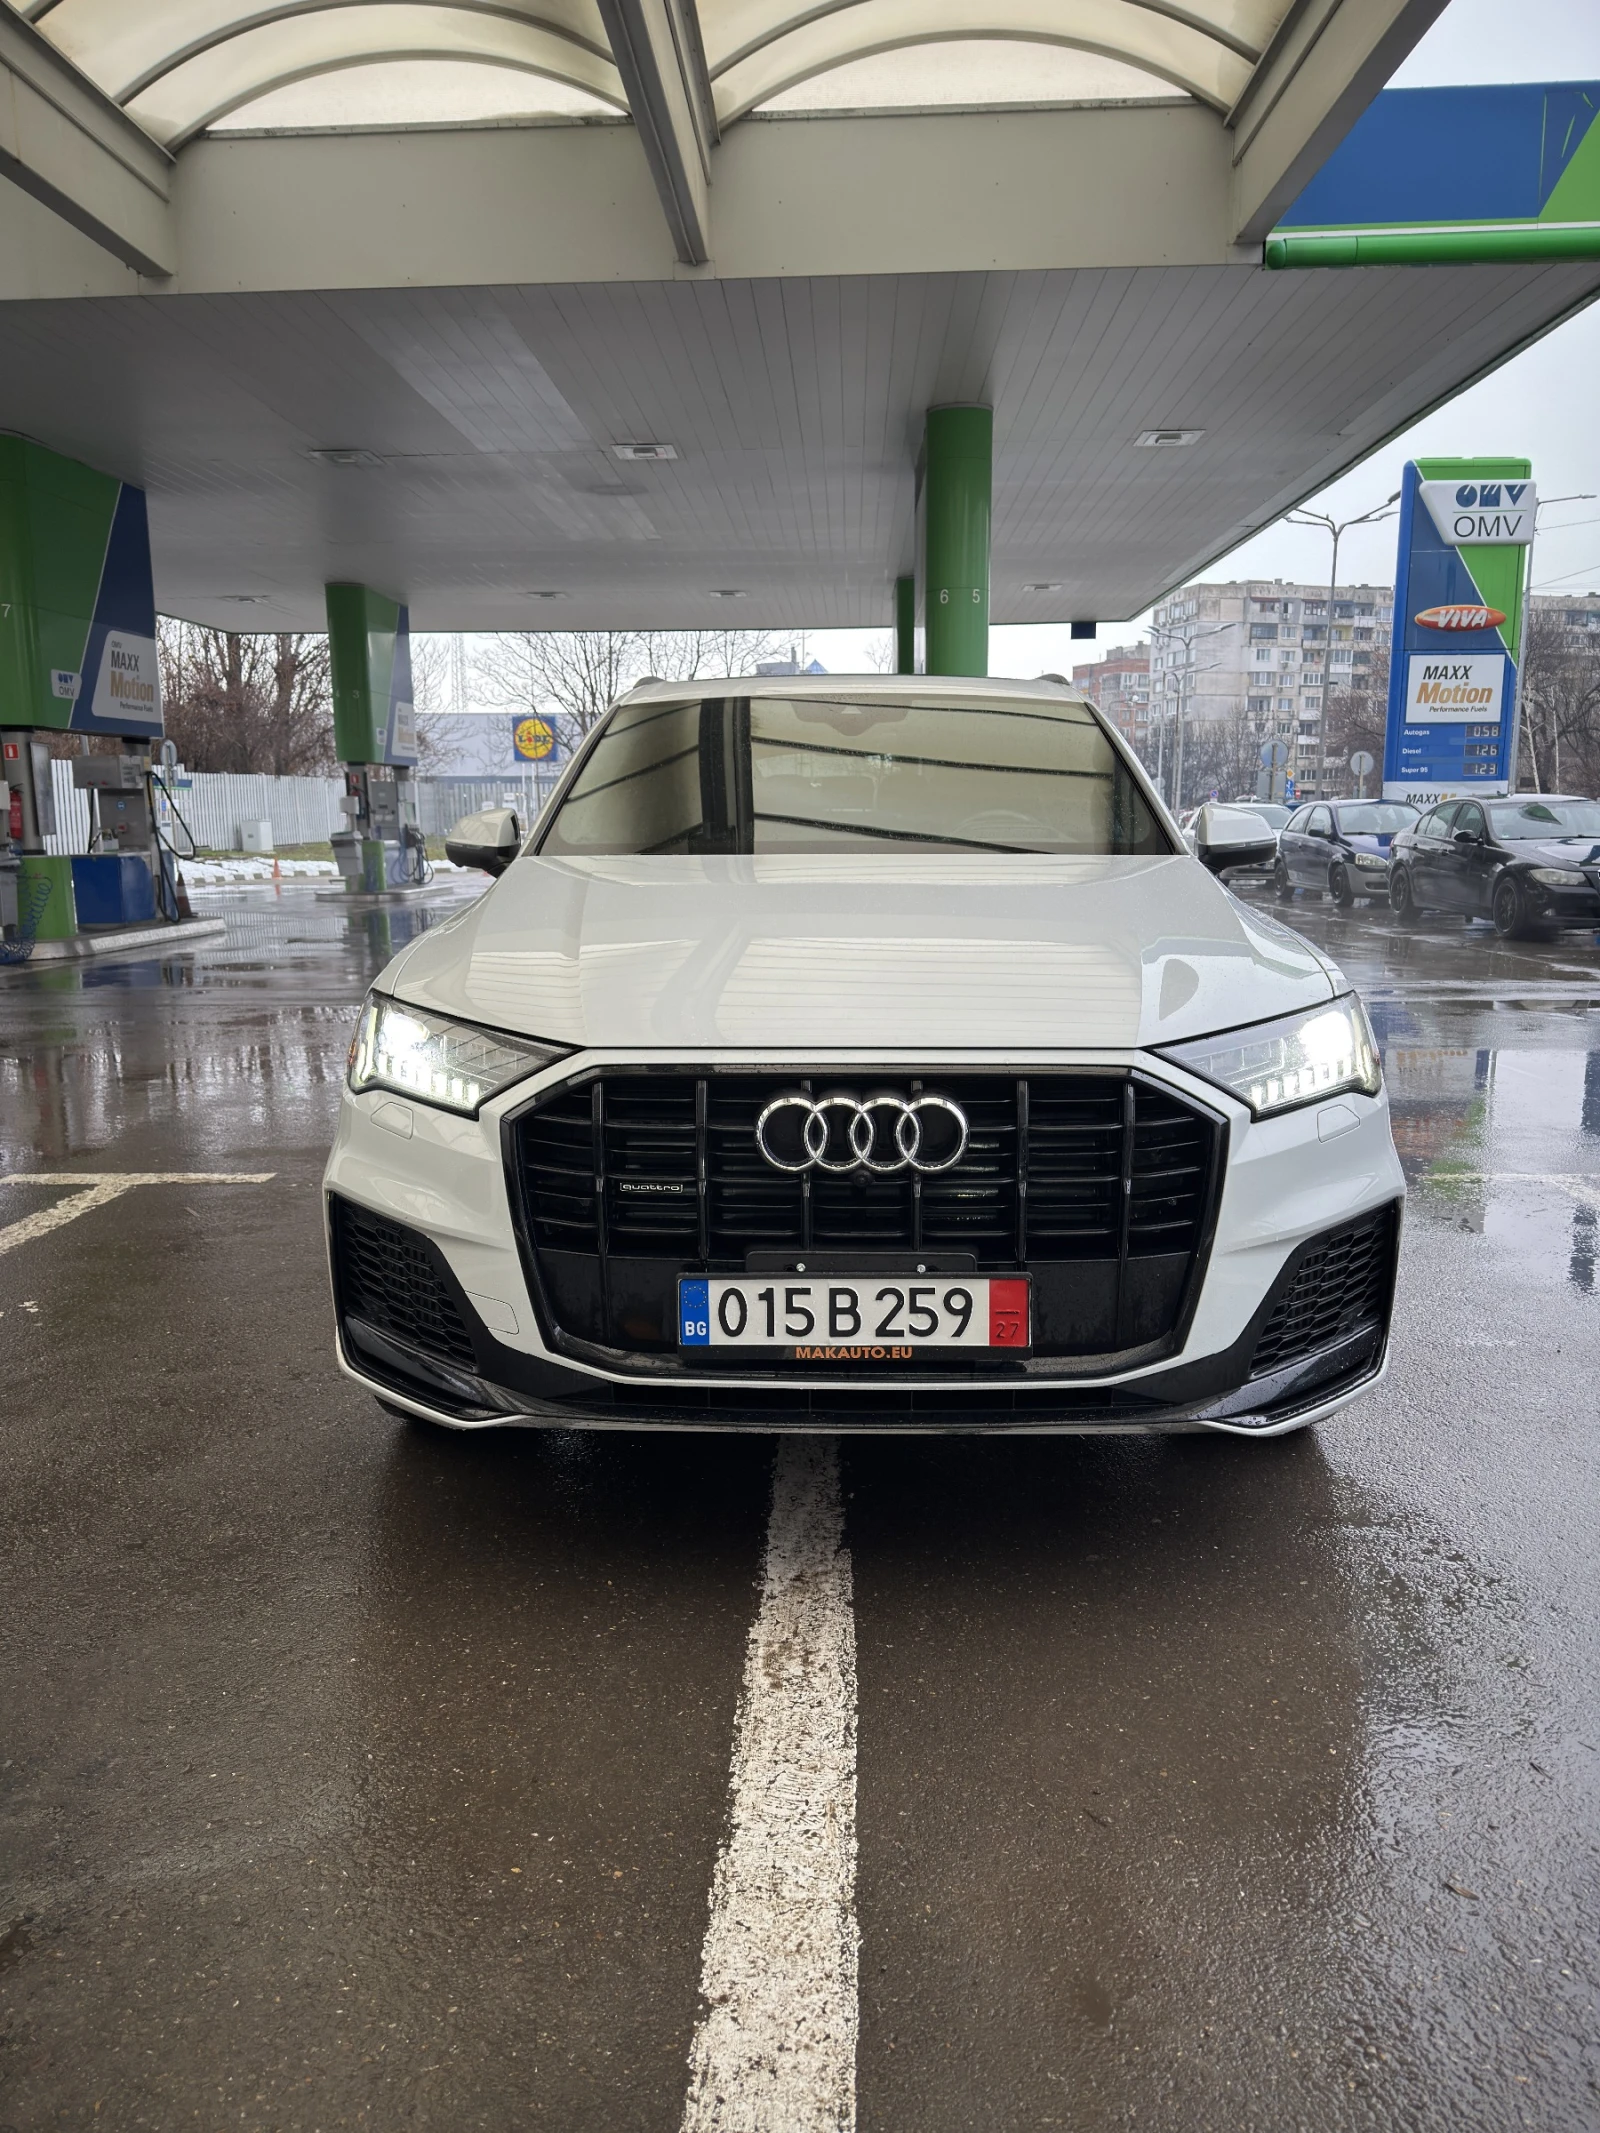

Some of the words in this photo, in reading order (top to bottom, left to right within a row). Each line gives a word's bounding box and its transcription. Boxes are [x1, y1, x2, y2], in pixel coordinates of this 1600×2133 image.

[1453, 514, 1523, 538] OMV
[939, 589, 949, 604] 6
[972, 589, 981, 604] 5
[1, 604, 11, 618] 7
[1437, 608, 1488, 628] VIVA
[110, 650, 140, 672] MAXX
[1422, 665, 1473, 680] MAXX
[58, 686, 75, 697] OMV
[110, 671, 154, 702] Motion
[1416, 682, 1493, 704] Motion
[622, 1183, 682, 1193] quattro
[684, 1321, 708, 1337] BG
[995, 1321, 1019, 1339] 27
[794, 1346, 914, 1360] MAKAUTO.EU
